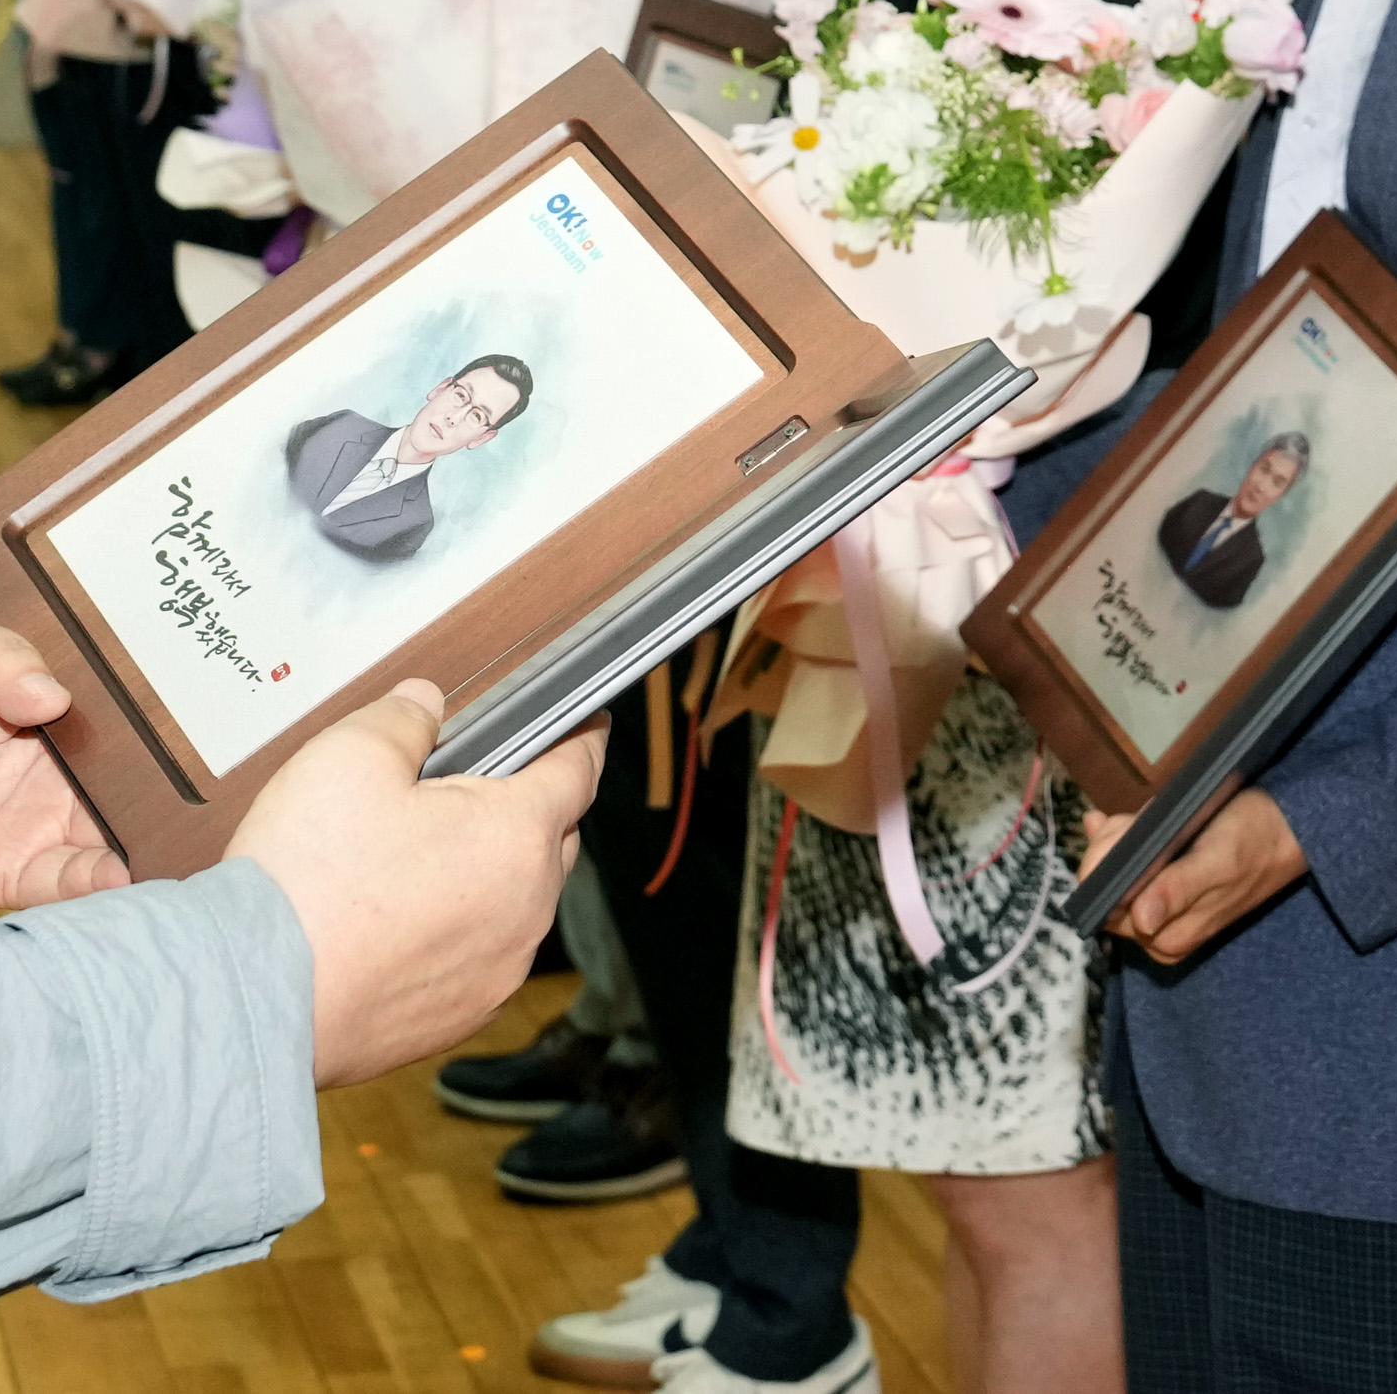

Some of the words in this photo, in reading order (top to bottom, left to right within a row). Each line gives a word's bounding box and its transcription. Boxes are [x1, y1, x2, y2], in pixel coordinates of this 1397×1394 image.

[529, 212, 587, 274] Jeonnam
[547, 193, 588, 233] OK!
[573, 228, 604, 261] Now
[151, 475, 252, 598] 함께라서
